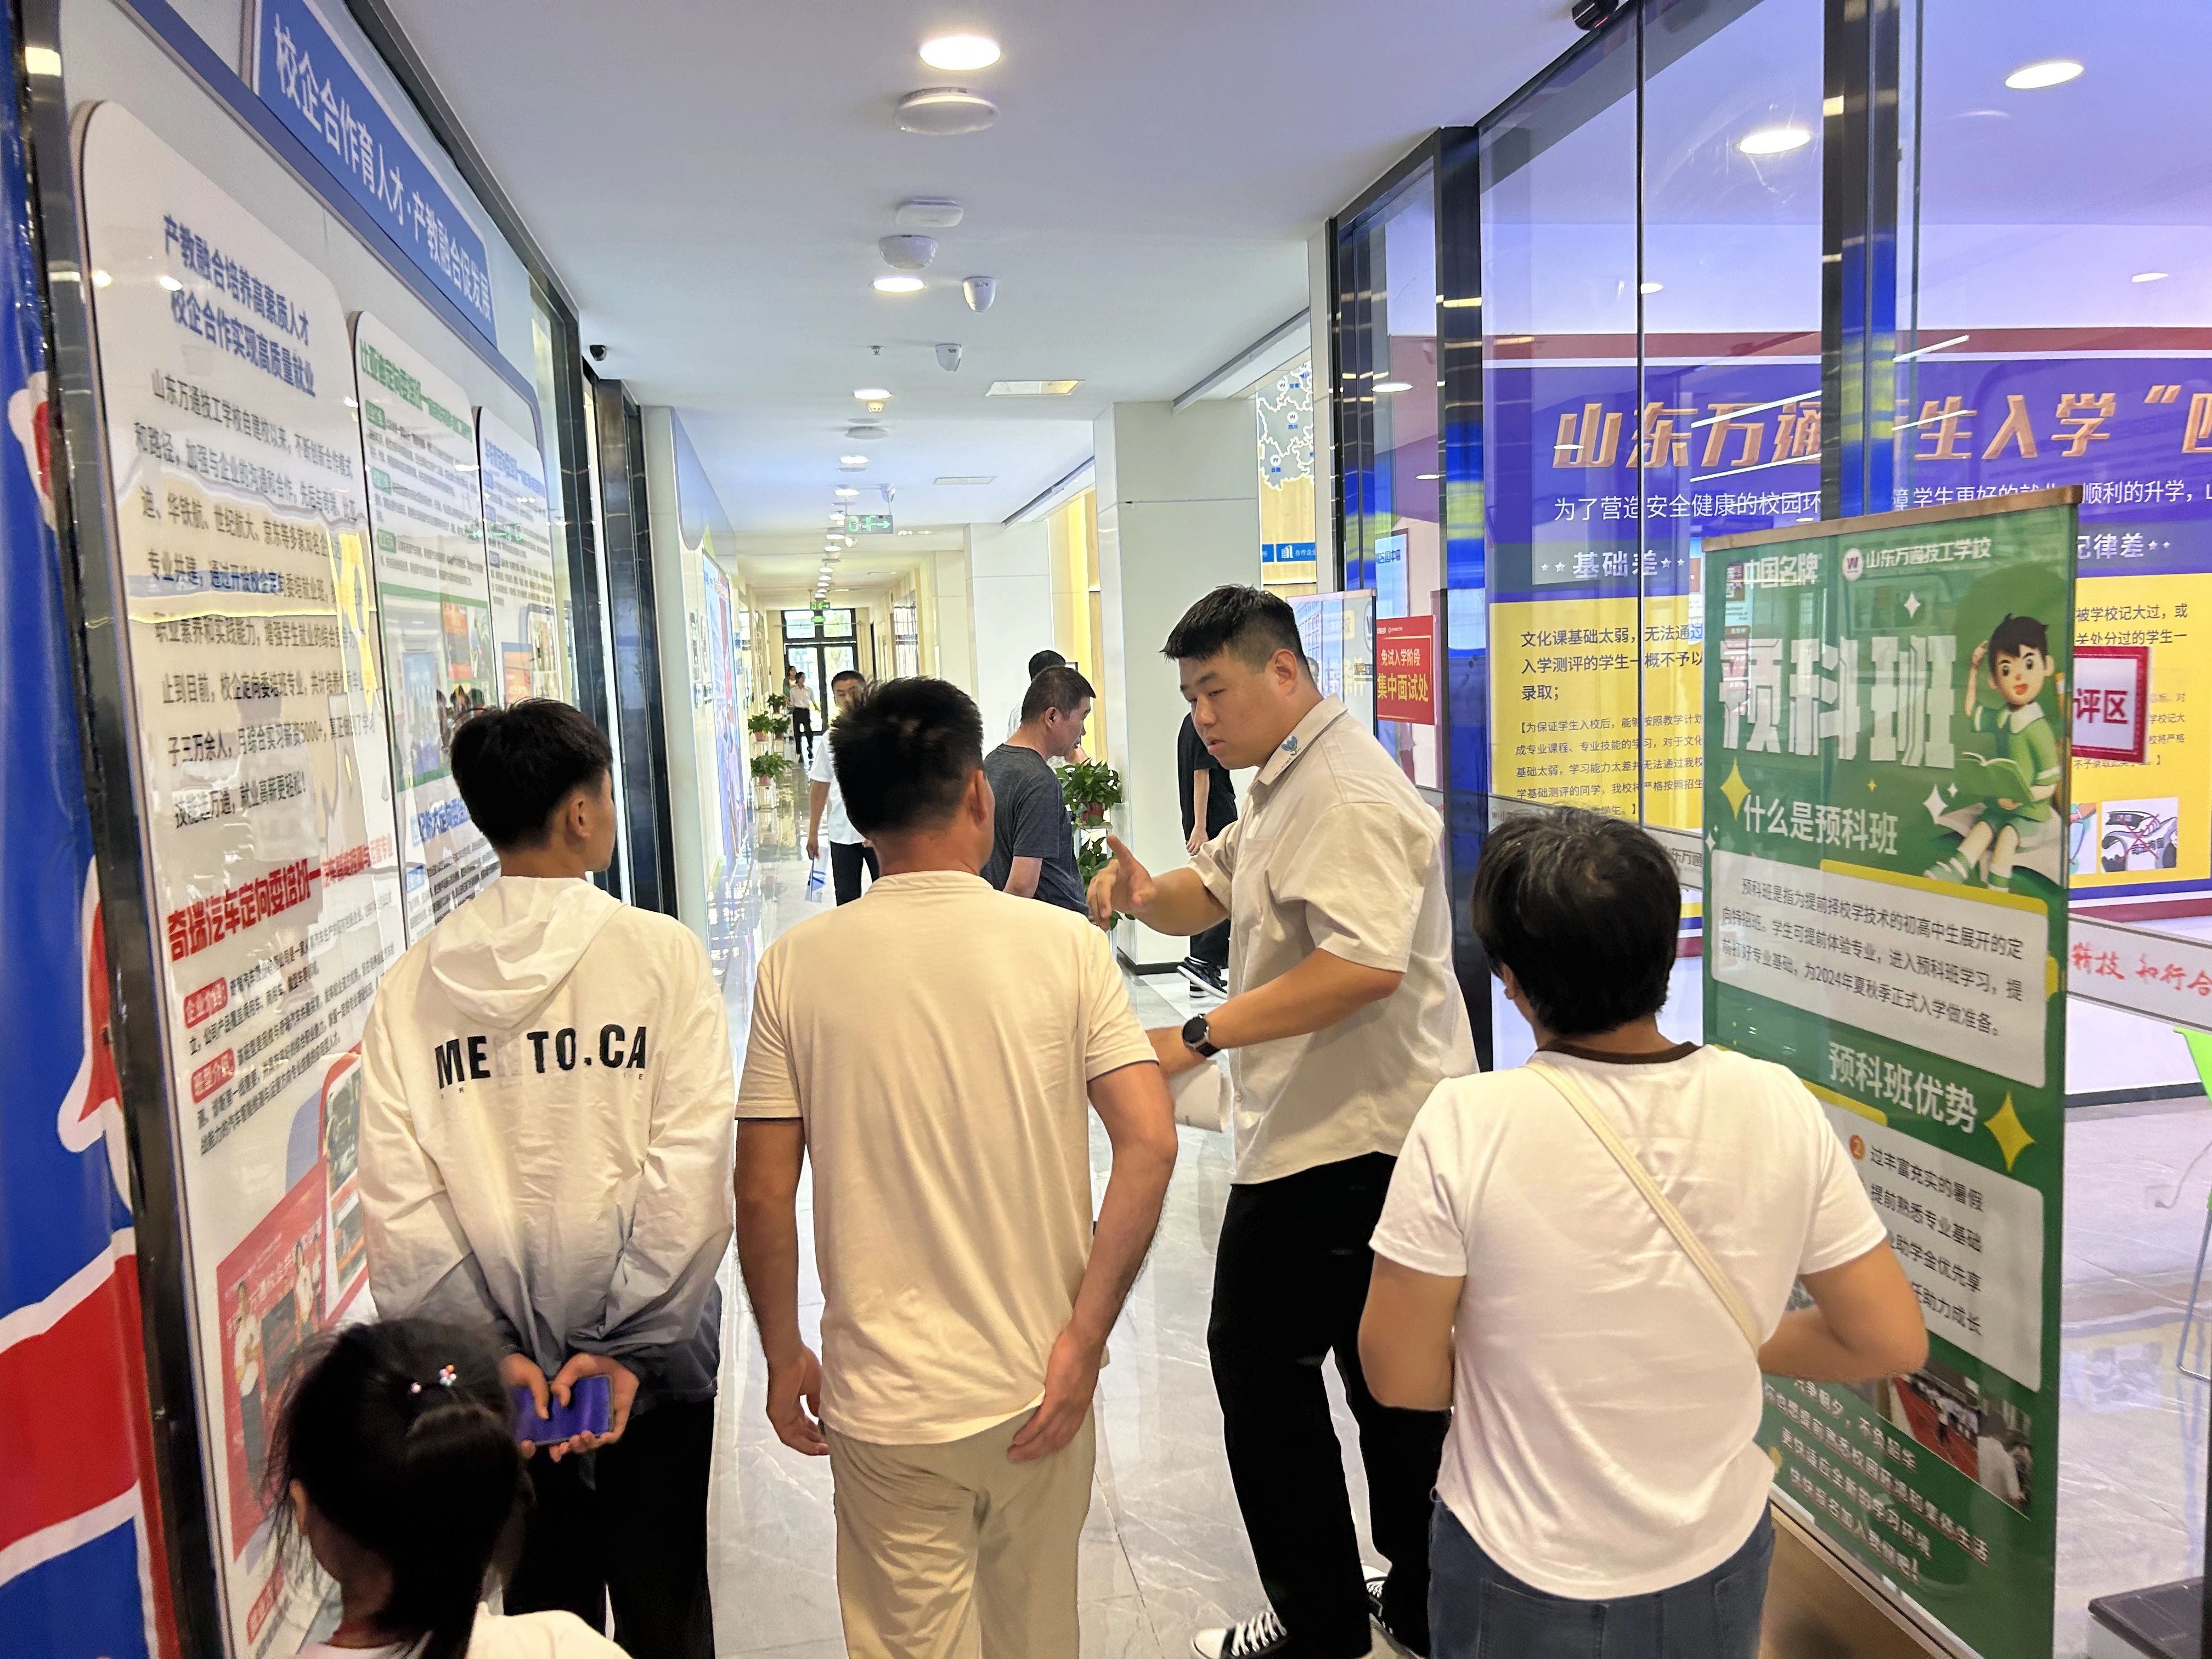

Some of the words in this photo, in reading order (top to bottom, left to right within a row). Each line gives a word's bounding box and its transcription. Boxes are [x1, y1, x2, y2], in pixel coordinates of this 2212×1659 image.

[163, 215, 309, 346] 产教融合培养高素质人才
[171, 289, 317, 398] 校企合作实现高质量就业
[1573, 550, 1657, 580] 基础差
[1745, 552, 1818, 589] 中国名牌
[1866, 538, 1992, 569] 山东万通技工学校
[1381, 648, 1421, 667] 免试入学阶段
[1378, 673, 1429, 702] 集中面试处
[1521, 685, 1560, 702] 录取；
[1719, 635, 1957, 770] 预科班
[2073, 687, 2129, 724] 评区
[1743, 793, 1899, 856] 什么是预科班
[435, 1036, 491, 1090] ME
[1829, 1041, 1977, 1135] 预科班优势
